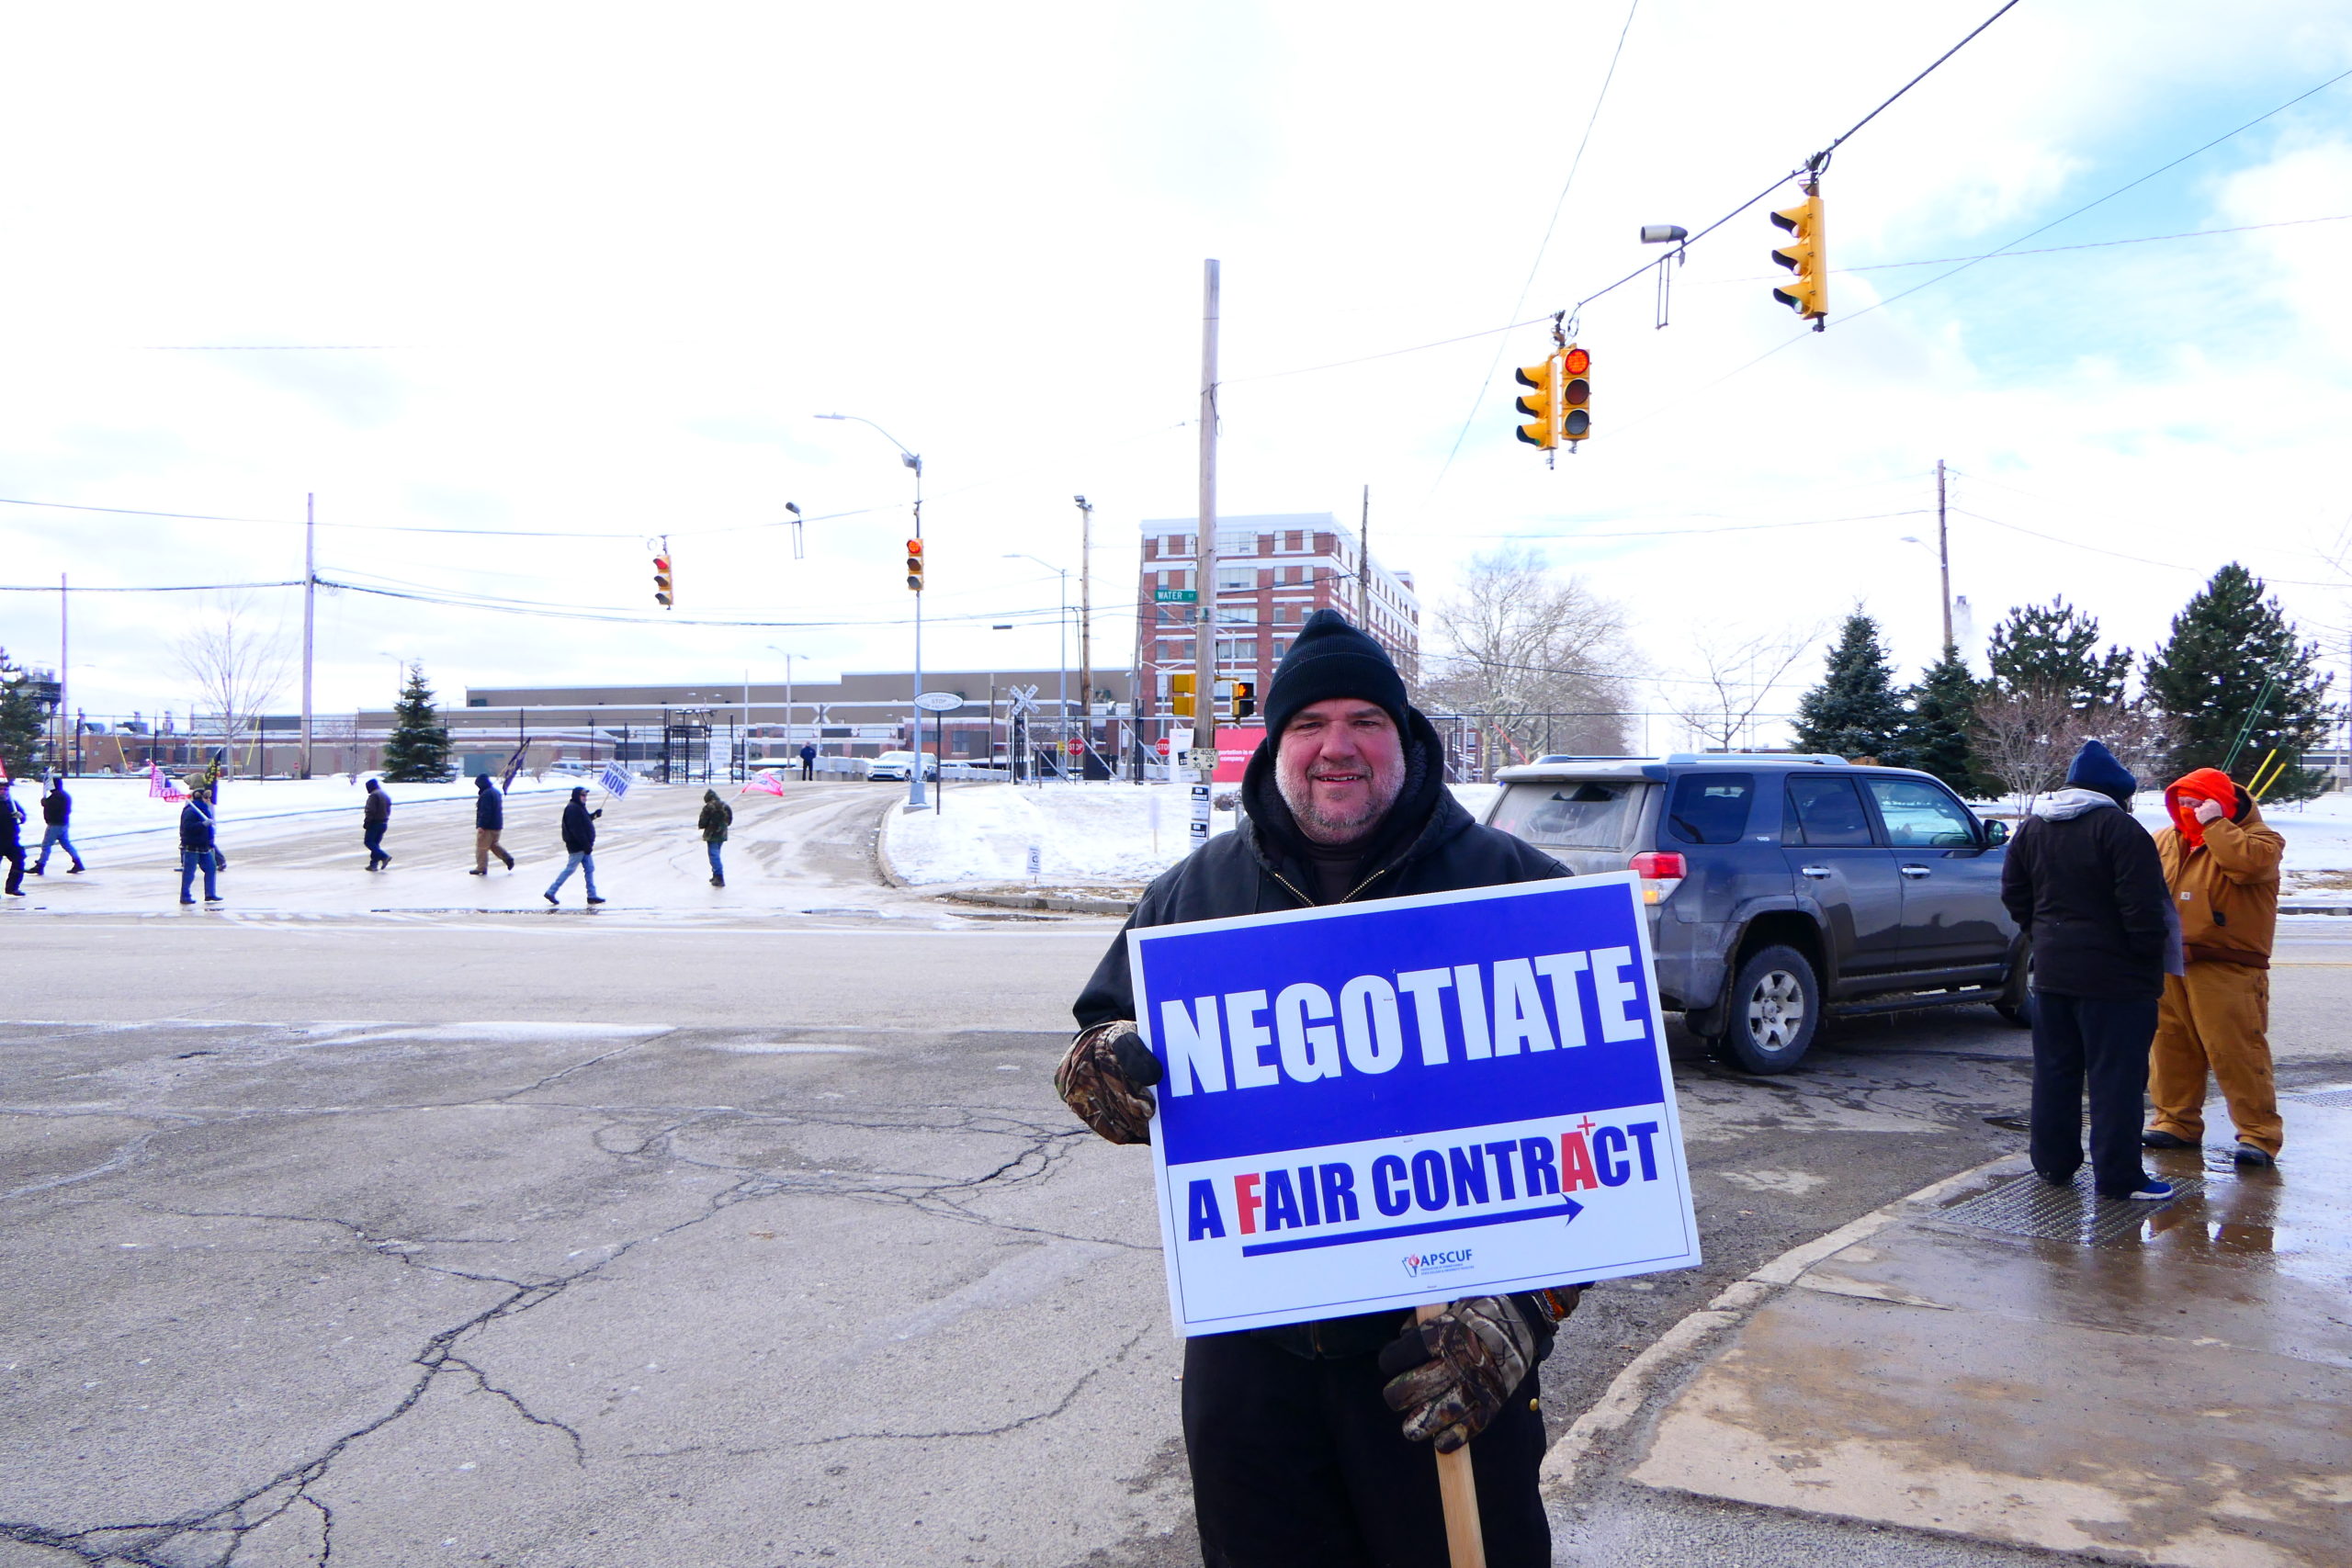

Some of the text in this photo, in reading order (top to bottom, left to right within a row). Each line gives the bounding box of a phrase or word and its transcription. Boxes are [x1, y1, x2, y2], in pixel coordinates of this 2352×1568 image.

[1158, 591, 1182, 600] WATER
[602, 770, 628, 796] NOW
[1159, 945, 1645, 1098] NEGOTIATE
[1188, 1120, 1660, 1242] A FAIR CONTRACT
[1420, 1248, 1473, 1267] APSCUF
